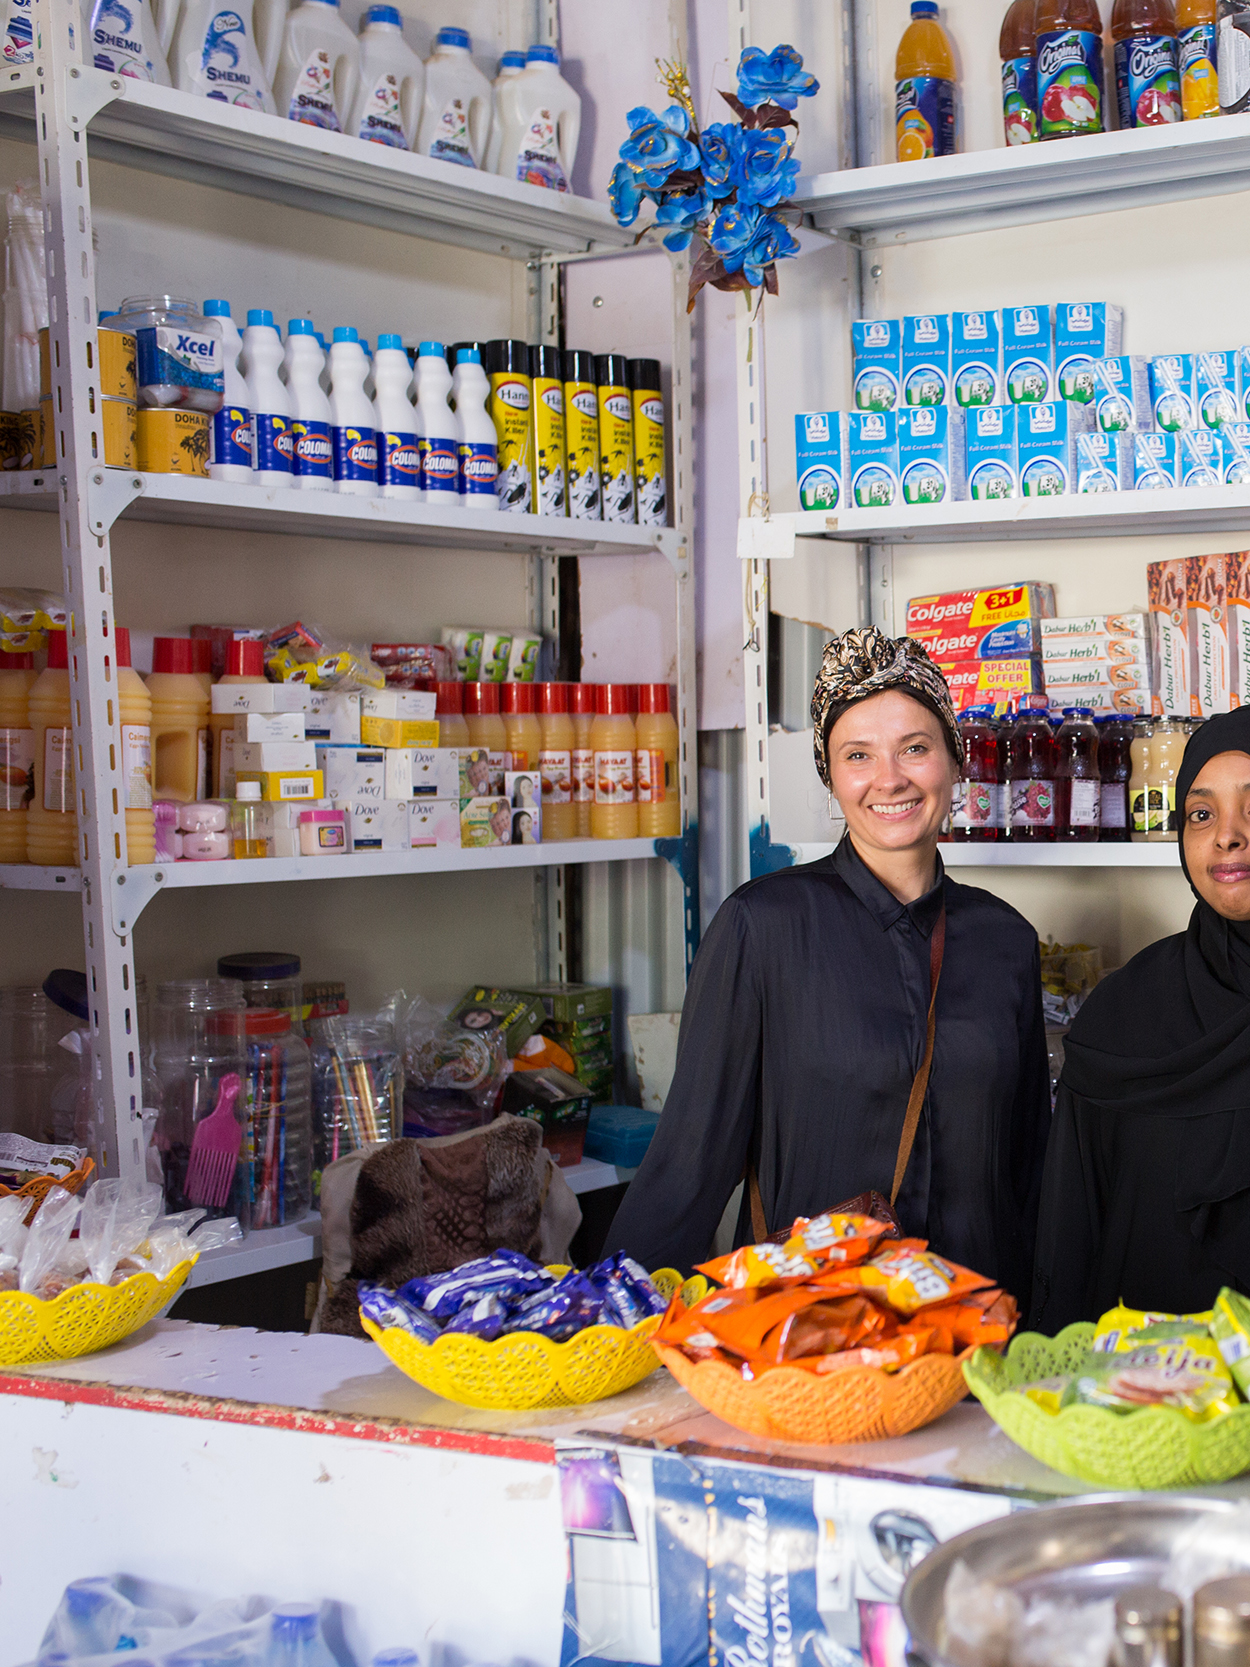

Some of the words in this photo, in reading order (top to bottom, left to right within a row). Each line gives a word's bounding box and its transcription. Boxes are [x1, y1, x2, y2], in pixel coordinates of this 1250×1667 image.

[214, 17, 241, 32] New
[93, 28, 143, 54] SHEMU
[1039, 42, 1084, 75] Original
[206, 66, 251, 86] SHEMU
[175, 333, 216, 358] Xcel
[174, 412, 200, 425] DOHA
[989, 591, 1015, 608] 3+1
[906, 601, 974, 623] Colgate
[981, 611, 1002, 622] FREE
[1044, 624, 1067, 634] Dabur
[1045, 650, 1068, 659] Dabur
[983, 661, 1030, 673] SPECIAL
[987, 671, 1024, 683] OFFER
[1047, 675, 1070, 683] Dabur
[1117, 681, 1135, 689] CLOVE
[1203, 669, 1213, 708] Dabur
[1164, 673, 1175, 710] Dabur
[233, 700, 250, 709] Dove
[310, 697, 329, 706] ove
[1050, 699, 1073, 708] Dabur
[1120, 706, 1138, 714] CLOVE
[413, 752, 435, 764] Dove
[600, 757, 627, 766] HAYAAT
[356, 786, 382, 797] Dove
[354, 804, 380, 815] Dove
[411, 804, 435, 815] Dove
